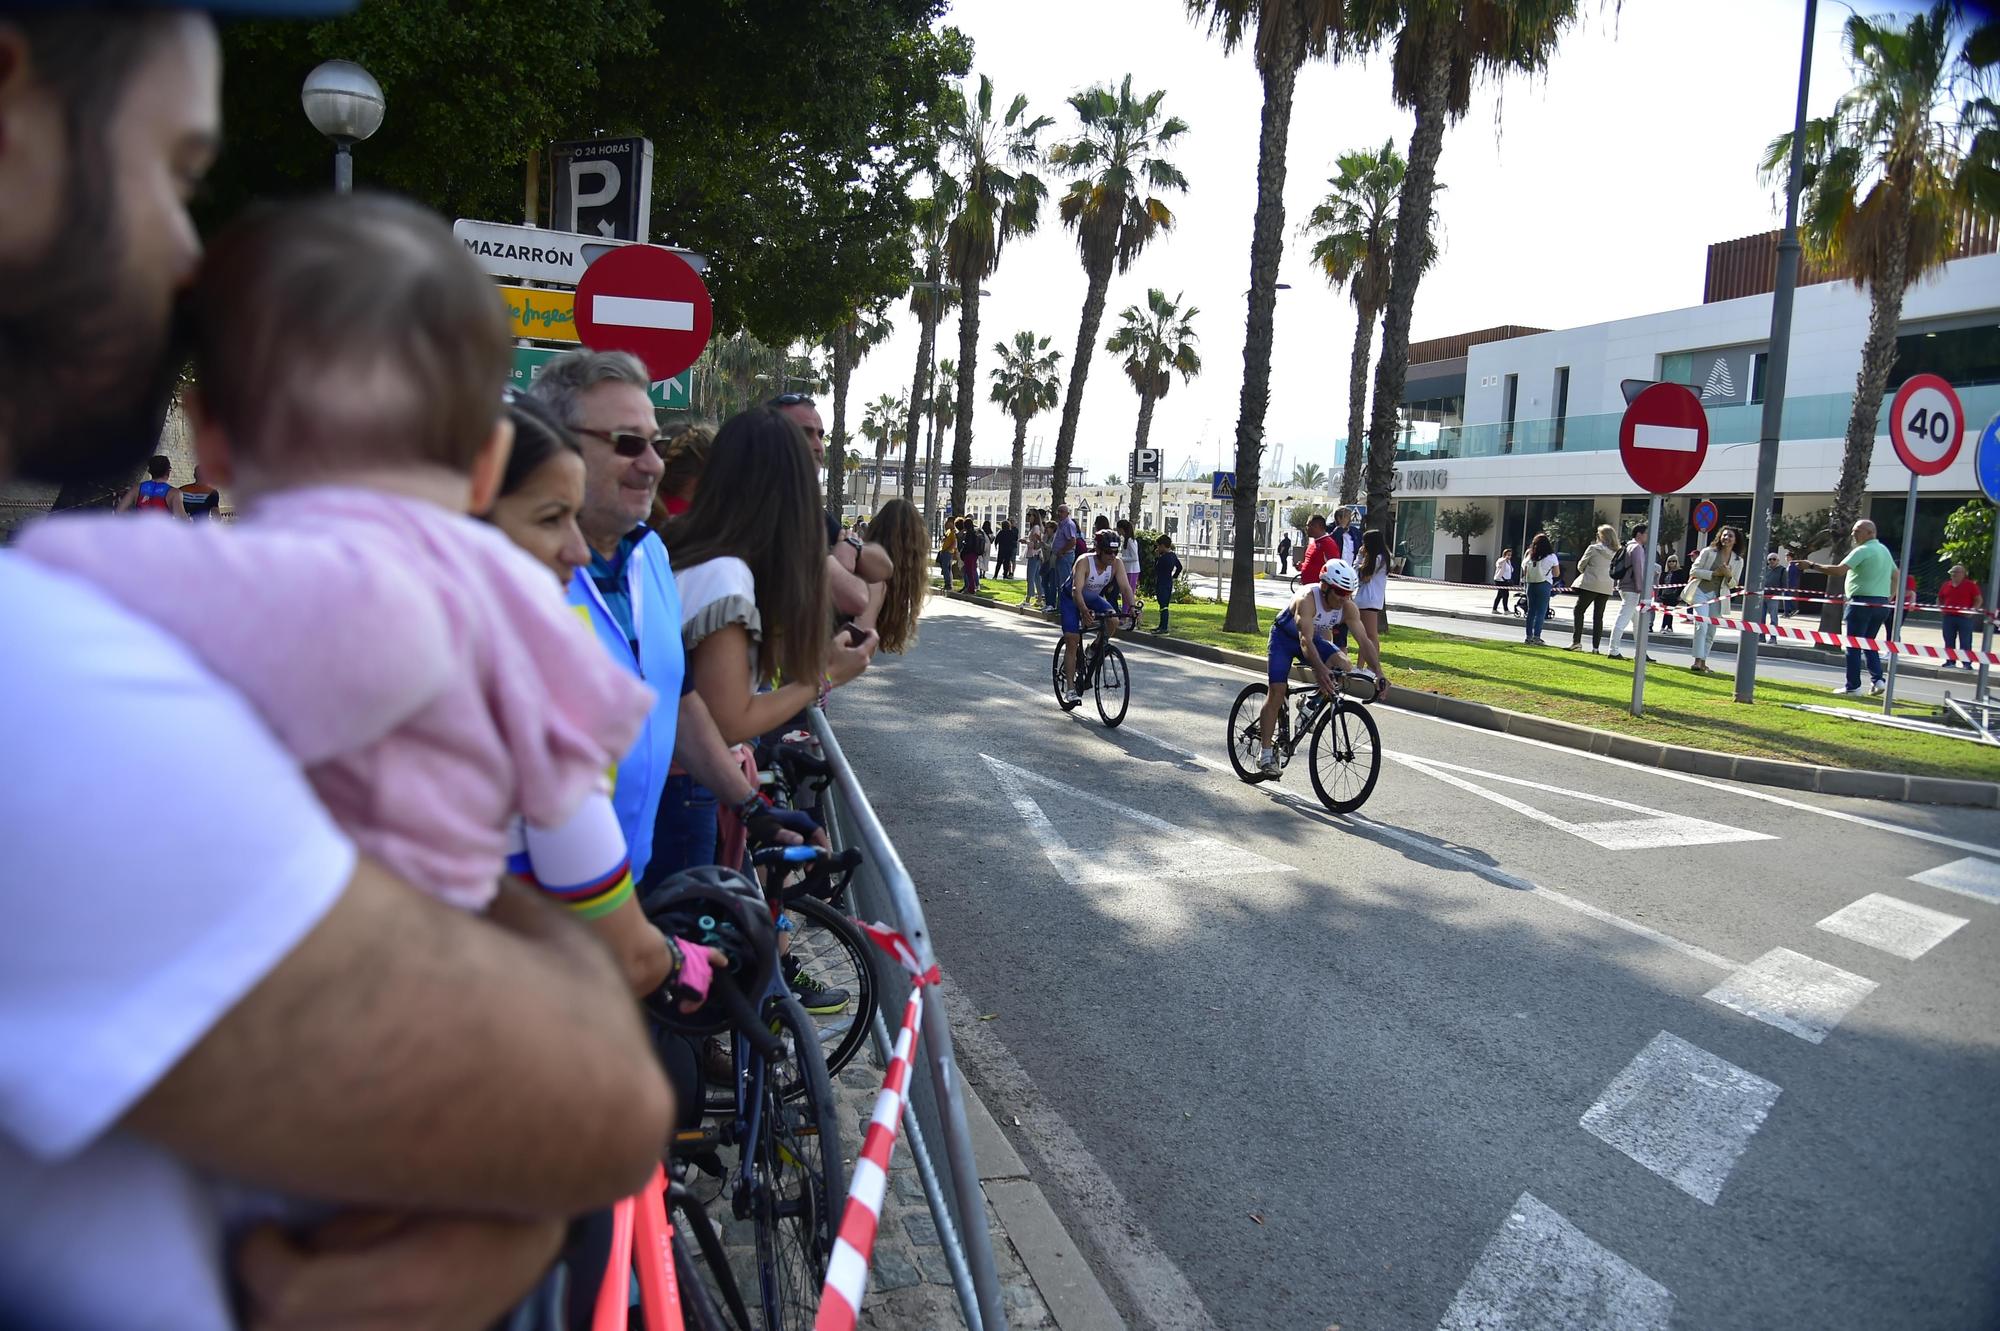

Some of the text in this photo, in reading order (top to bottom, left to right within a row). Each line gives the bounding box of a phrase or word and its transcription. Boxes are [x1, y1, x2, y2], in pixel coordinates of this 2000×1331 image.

[585, 146, 596, 156] 24
[598, 143, 630, 155] HORAS
[569, 160, 622, 234] P
[463, 239, 573, 267] MAZARRÓN
[1908, 407, 1949, 444] 40
[1137, 450, 1157, 472] P
[1406, 469, 1448, 490] KING
